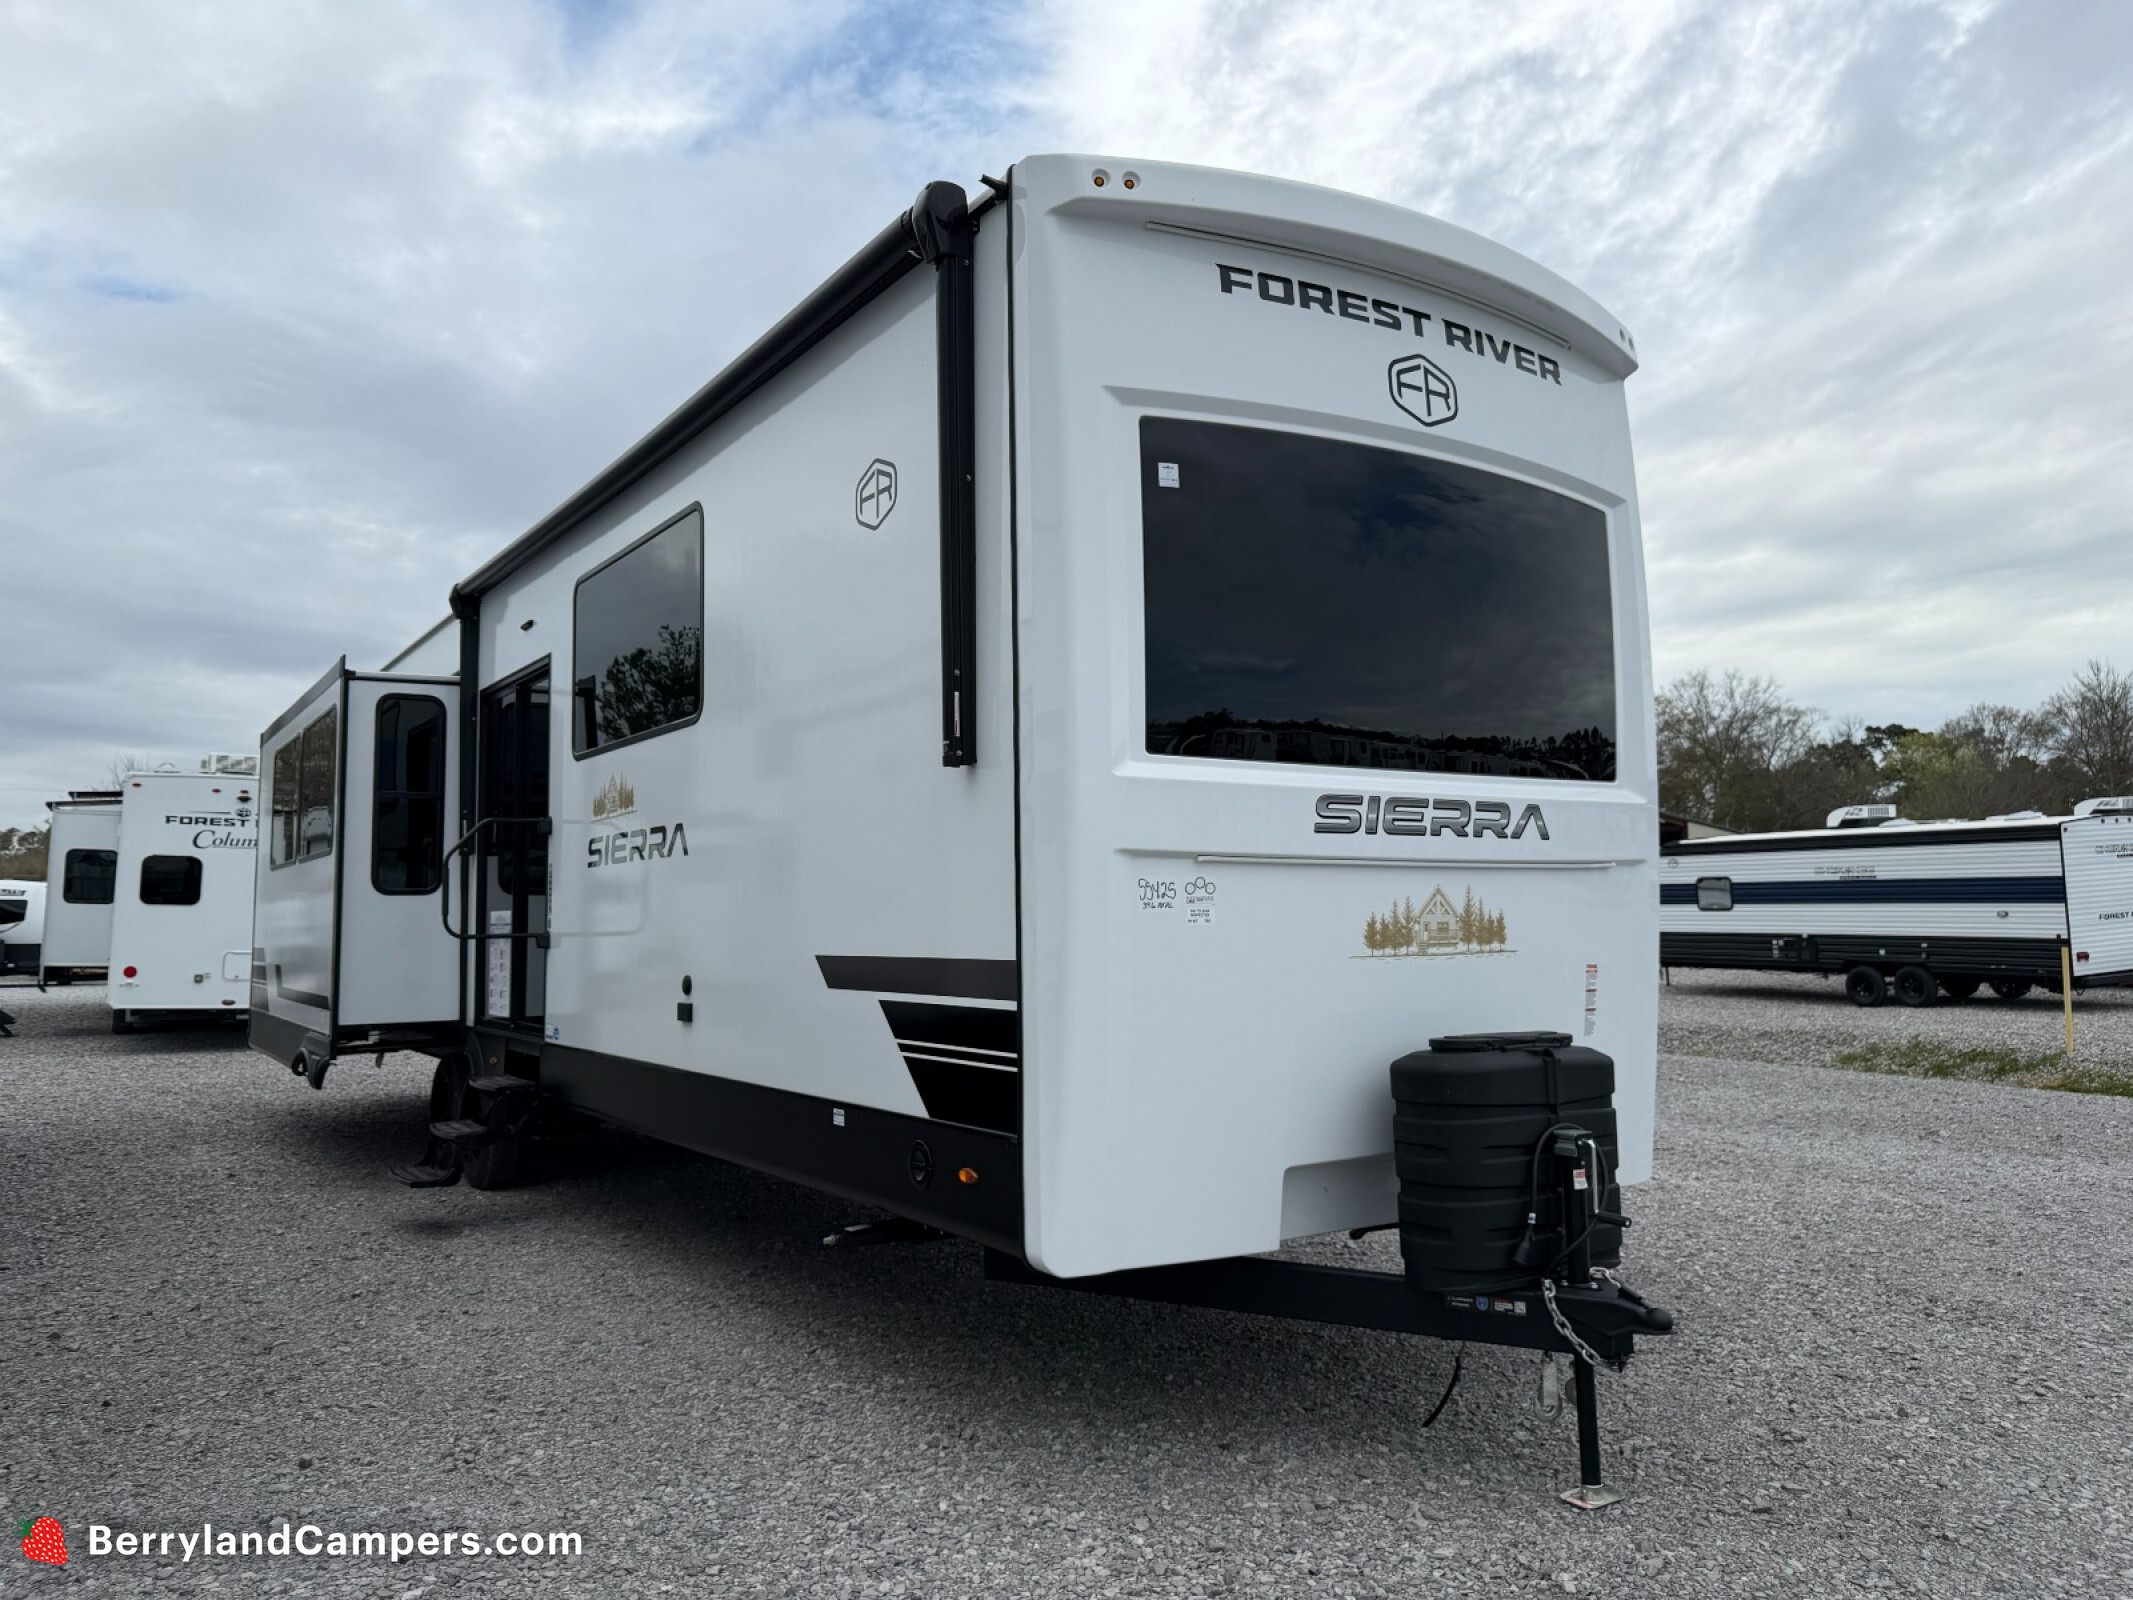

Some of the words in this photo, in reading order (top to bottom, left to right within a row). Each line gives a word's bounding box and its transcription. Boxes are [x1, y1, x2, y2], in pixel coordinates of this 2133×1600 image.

[1215, 263, 1431, 338] FOREST
[1441, 317, 1562, 386] RIVER
[164, 815, 251, 828] FOREST
[1314, 793, 1550, 841] SIERRA
[587, 822, 689, 869] SIERRA
[2098, 911, 2130, 921] FOREST
